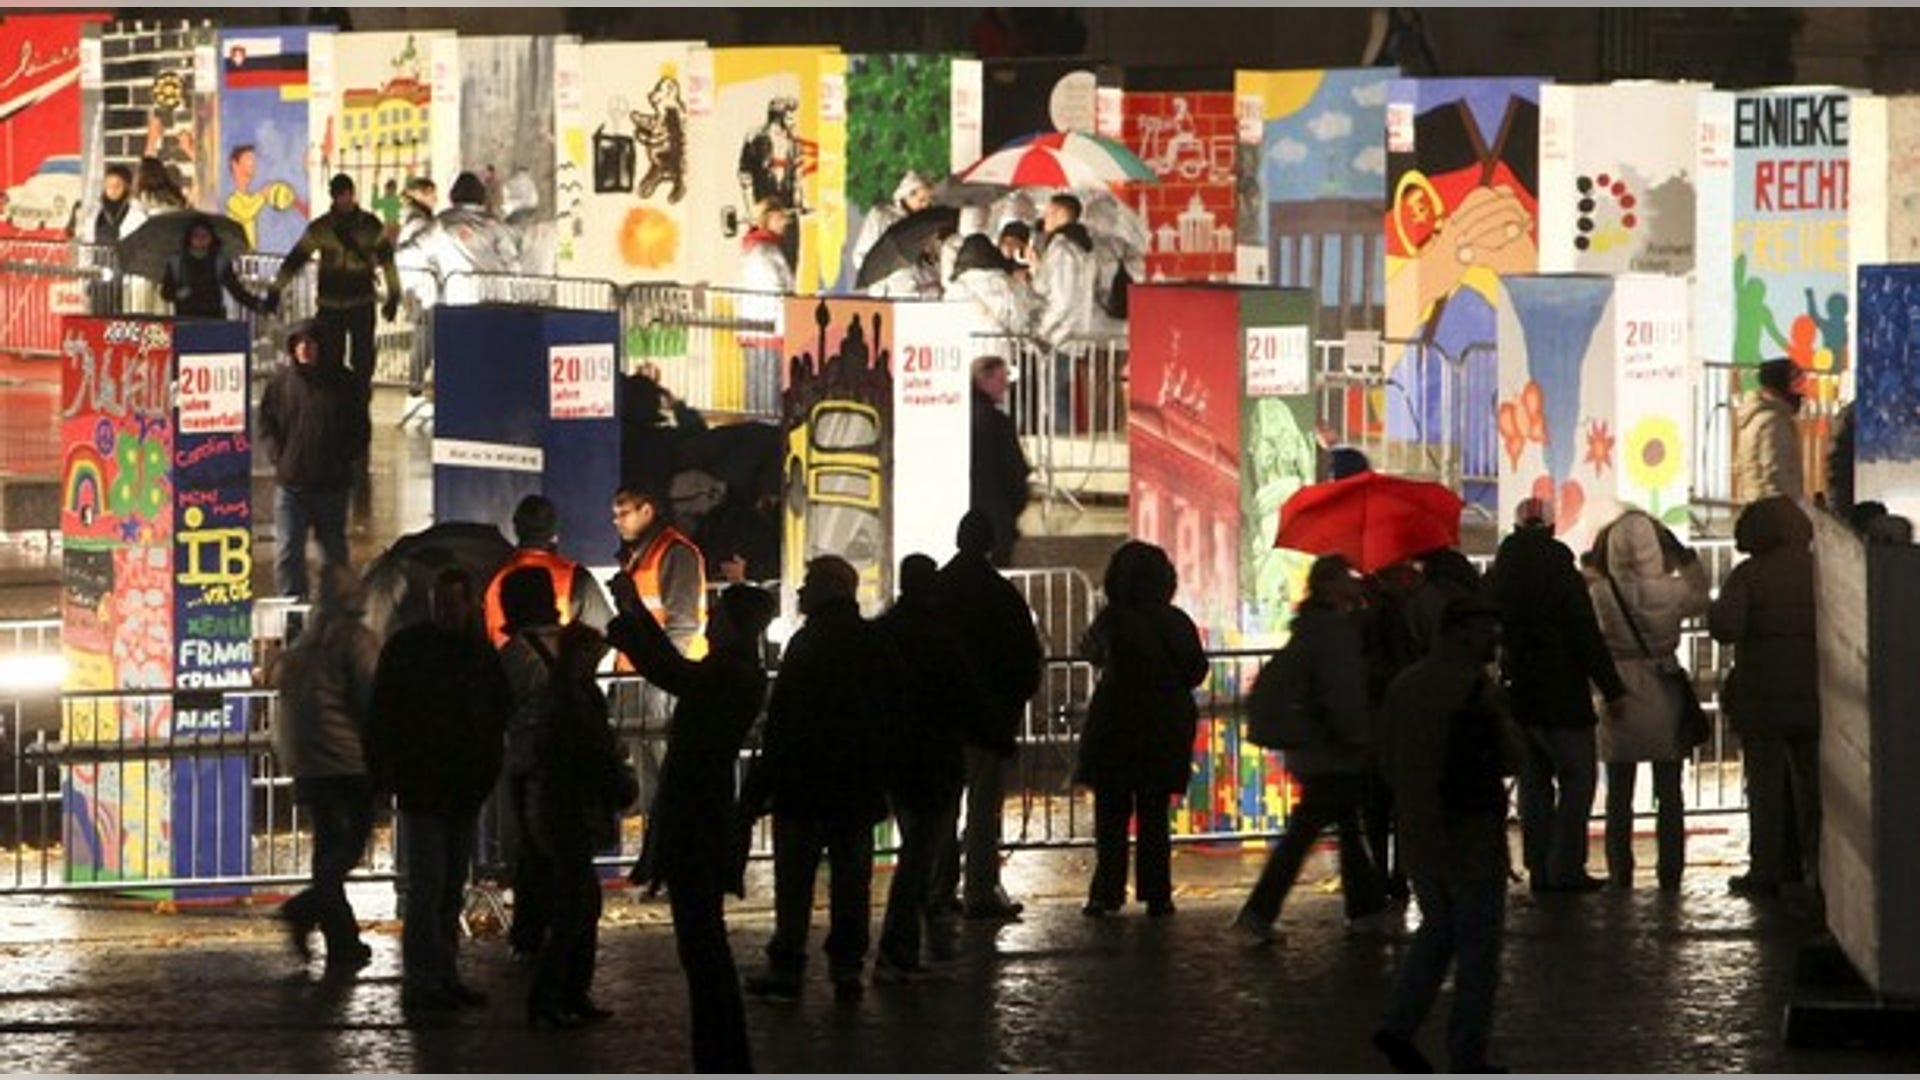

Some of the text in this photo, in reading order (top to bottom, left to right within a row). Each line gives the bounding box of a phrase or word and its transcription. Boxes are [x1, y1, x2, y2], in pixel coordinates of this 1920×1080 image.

[1735, 95, 1849, 148] EINIGKE
[1755, 160, 1849, 212] RECHT
[552, 355, 613, 383] 2009
[902, 344, 961, 372] 2009
[180, 364, 242, 396] 2009
